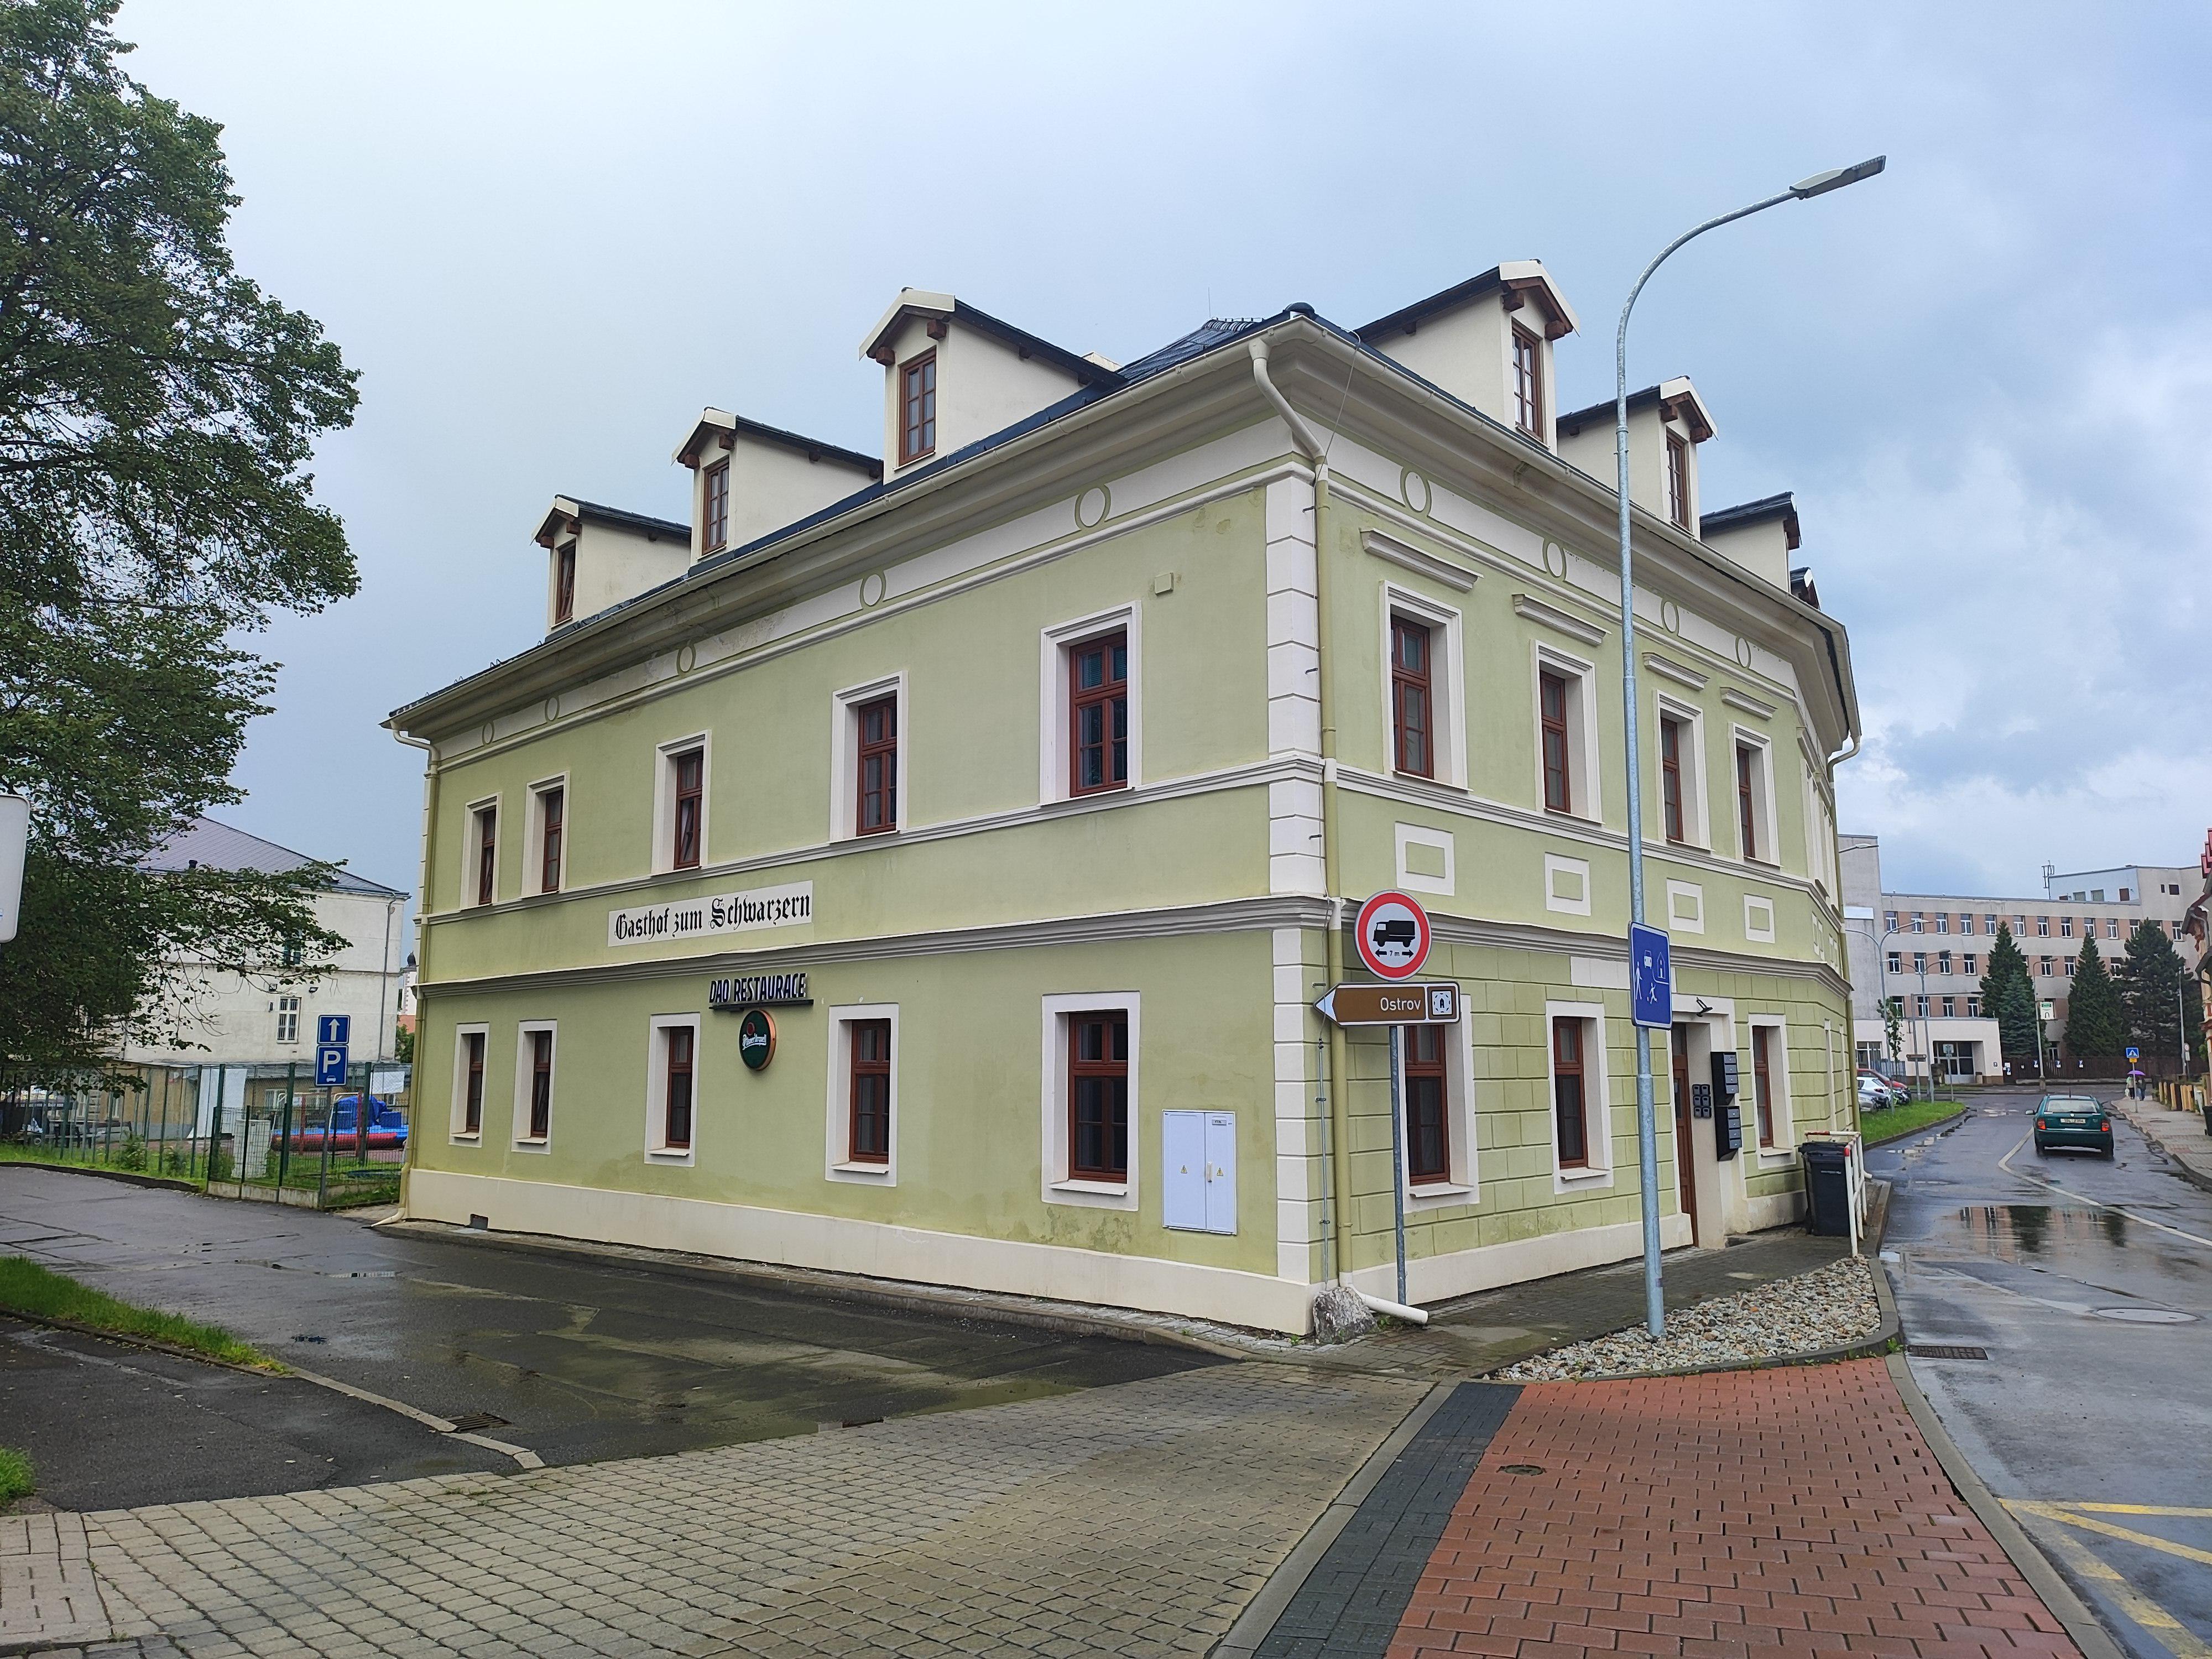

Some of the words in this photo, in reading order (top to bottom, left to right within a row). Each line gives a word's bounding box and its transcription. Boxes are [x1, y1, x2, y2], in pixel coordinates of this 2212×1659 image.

[614, 907, 670, 940] Gasthof
[672, 909, 702, 938] zum
[708, 894, 811, 930] Schwarzern
[709, 979, 731, 1003] DAO
[733, 973, 807, 1002] RESTAURACE
[1380, 997, 1421, 1011] Ostrov
[322, 1050, 341, 1073] P
